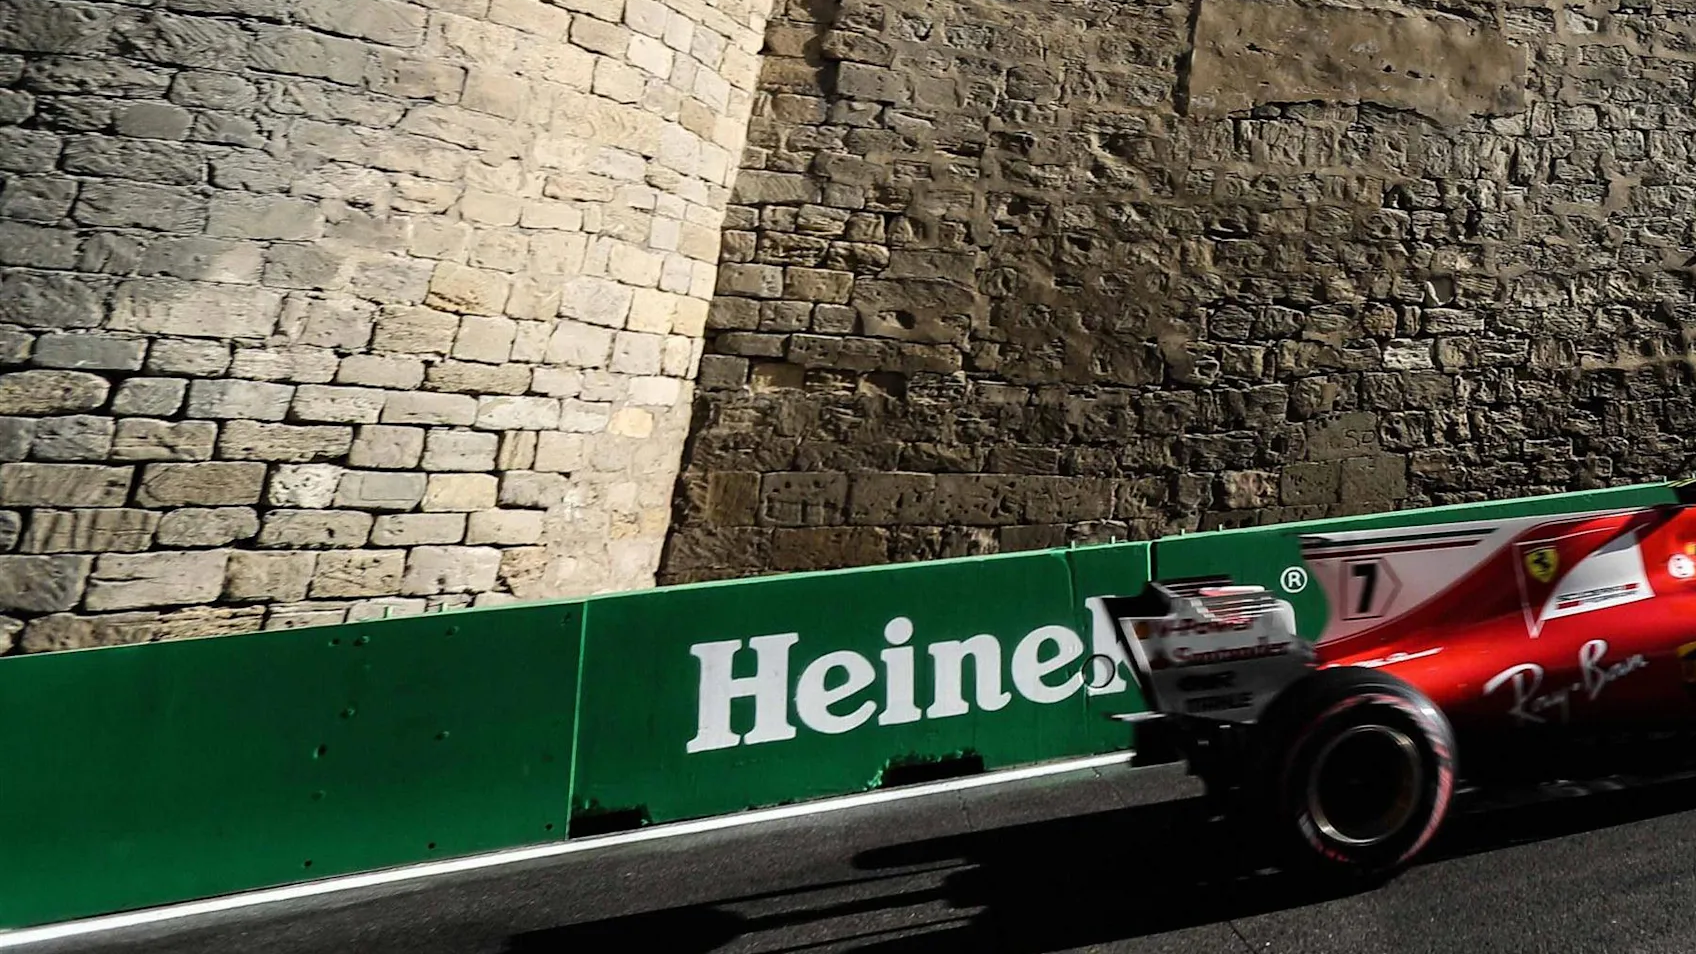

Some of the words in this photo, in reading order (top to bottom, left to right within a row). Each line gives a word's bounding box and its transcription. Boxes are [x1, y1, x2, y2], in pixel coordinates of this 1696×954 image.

[1352, 563, 1378, 614] 7
[687, 595, 1143, 753] Heinek
[1482, 639, 1649, 724] Ray-Ban
